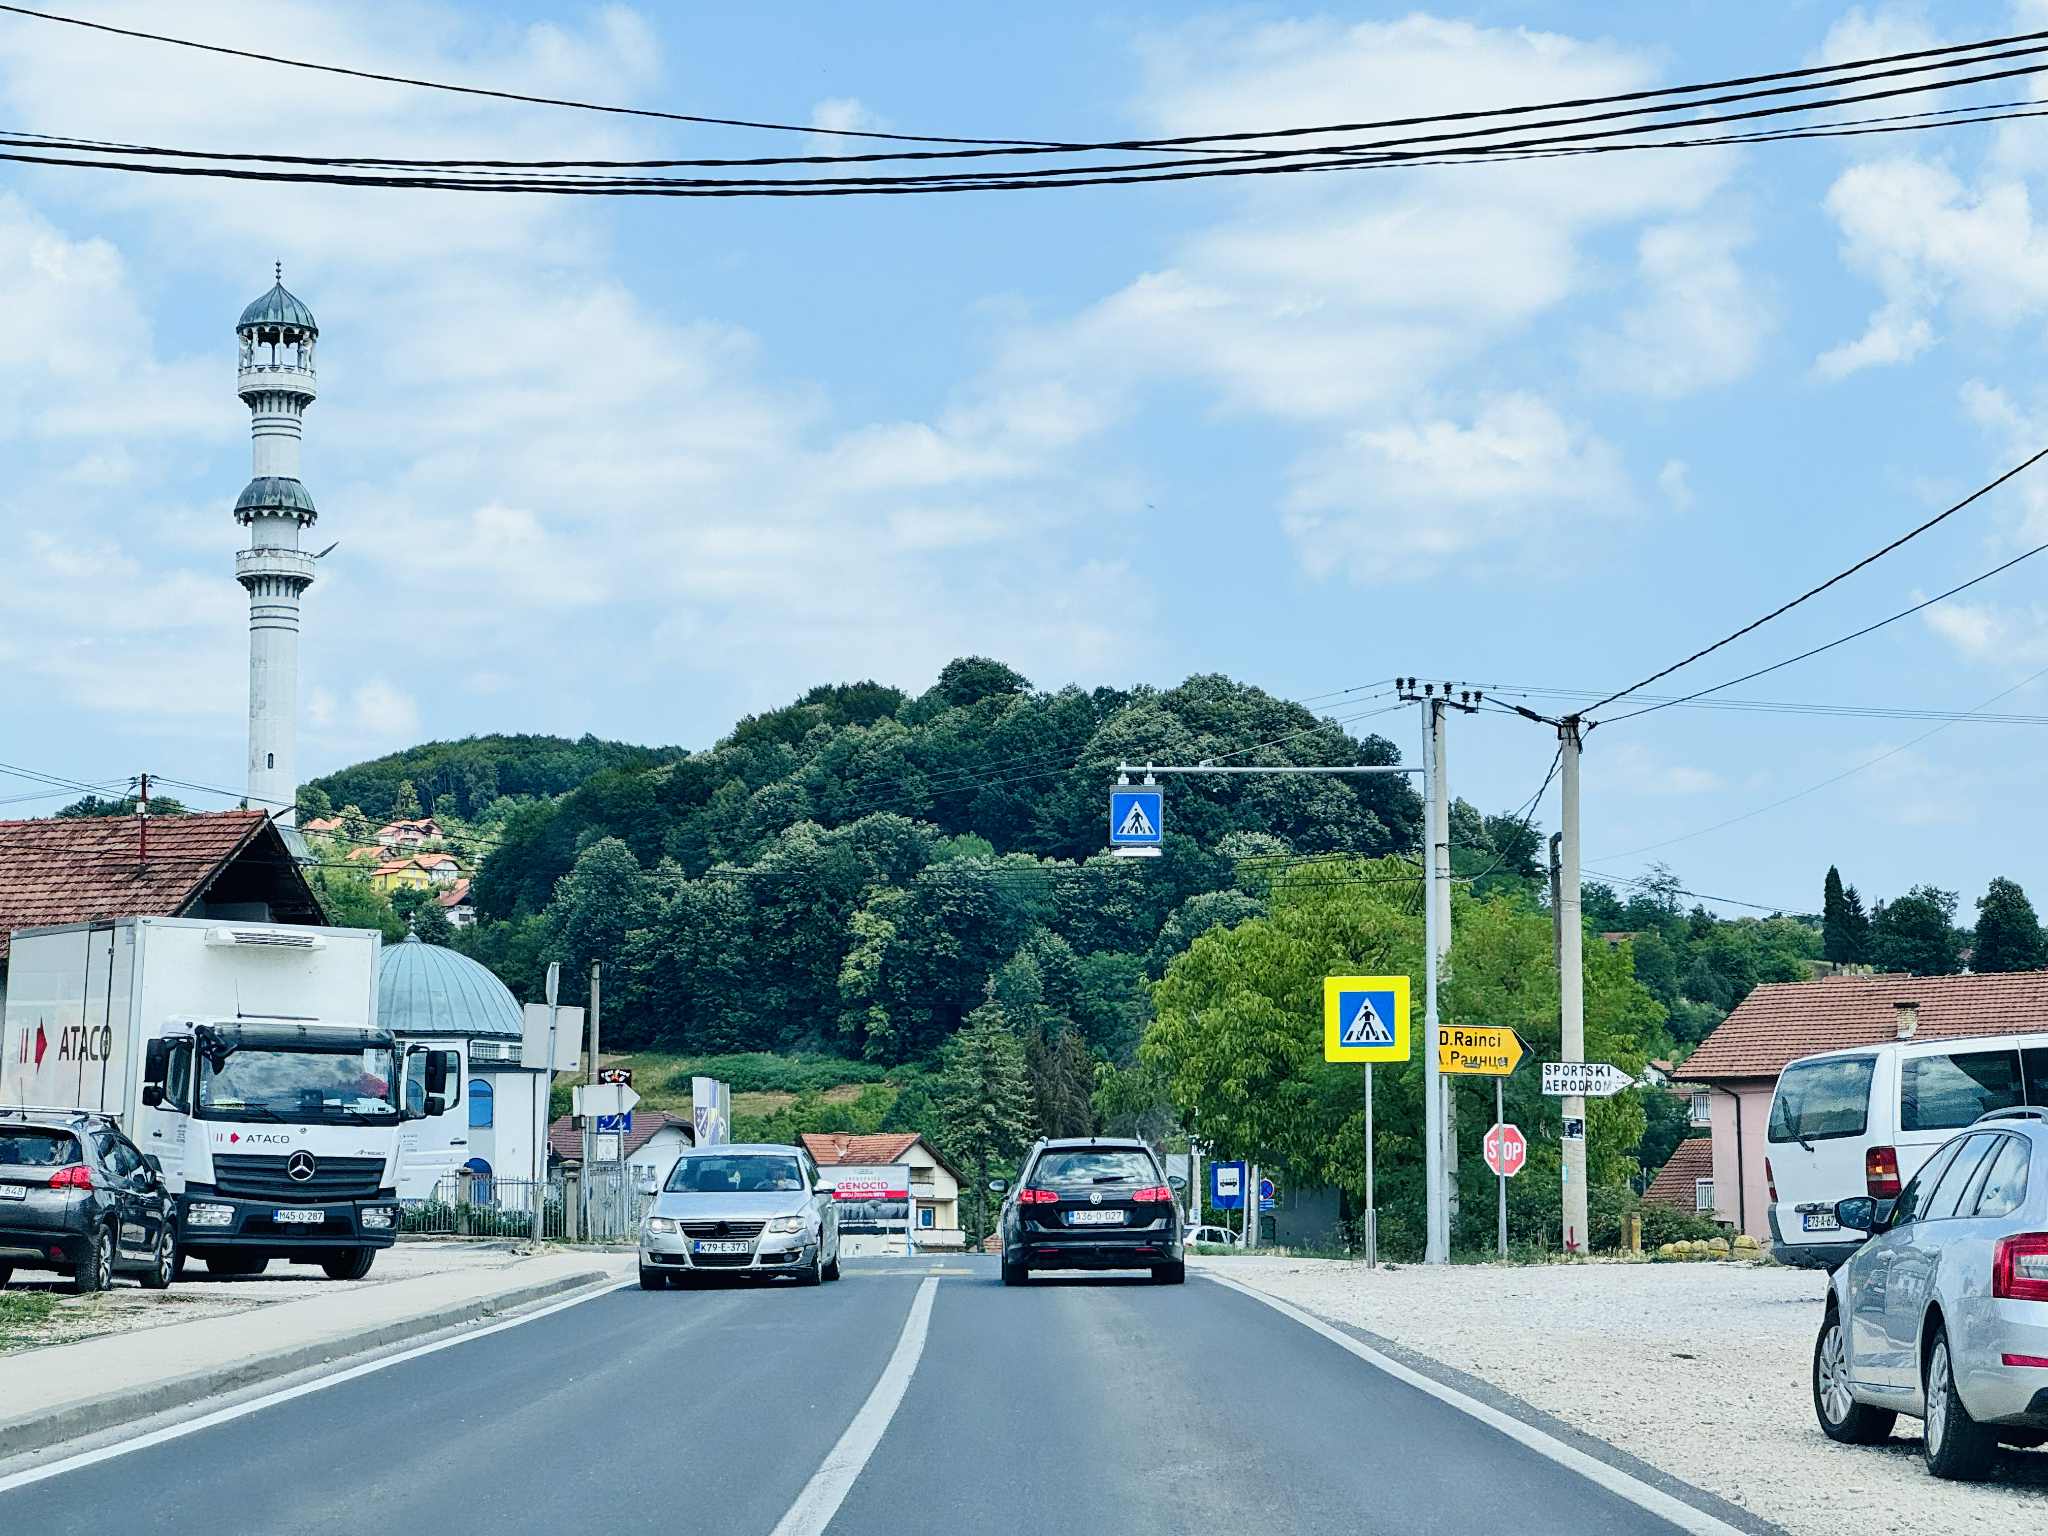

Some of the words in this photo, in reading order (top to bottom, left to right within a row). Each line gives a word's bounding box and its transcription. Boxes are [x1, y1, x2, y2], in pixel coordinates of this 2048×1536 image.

[58, 1026, 112, 1061] ATACO
[1439, 1031, 1501, 1047] D.Rainci
[1545, 1065, 1611, 1077] SPORTSKI
[246, 1135, 290, 1144] ATACO
[837, 1182, 889, 1190] GENOCID
[1807, 1216, 1838, 1227] E73-A-67
